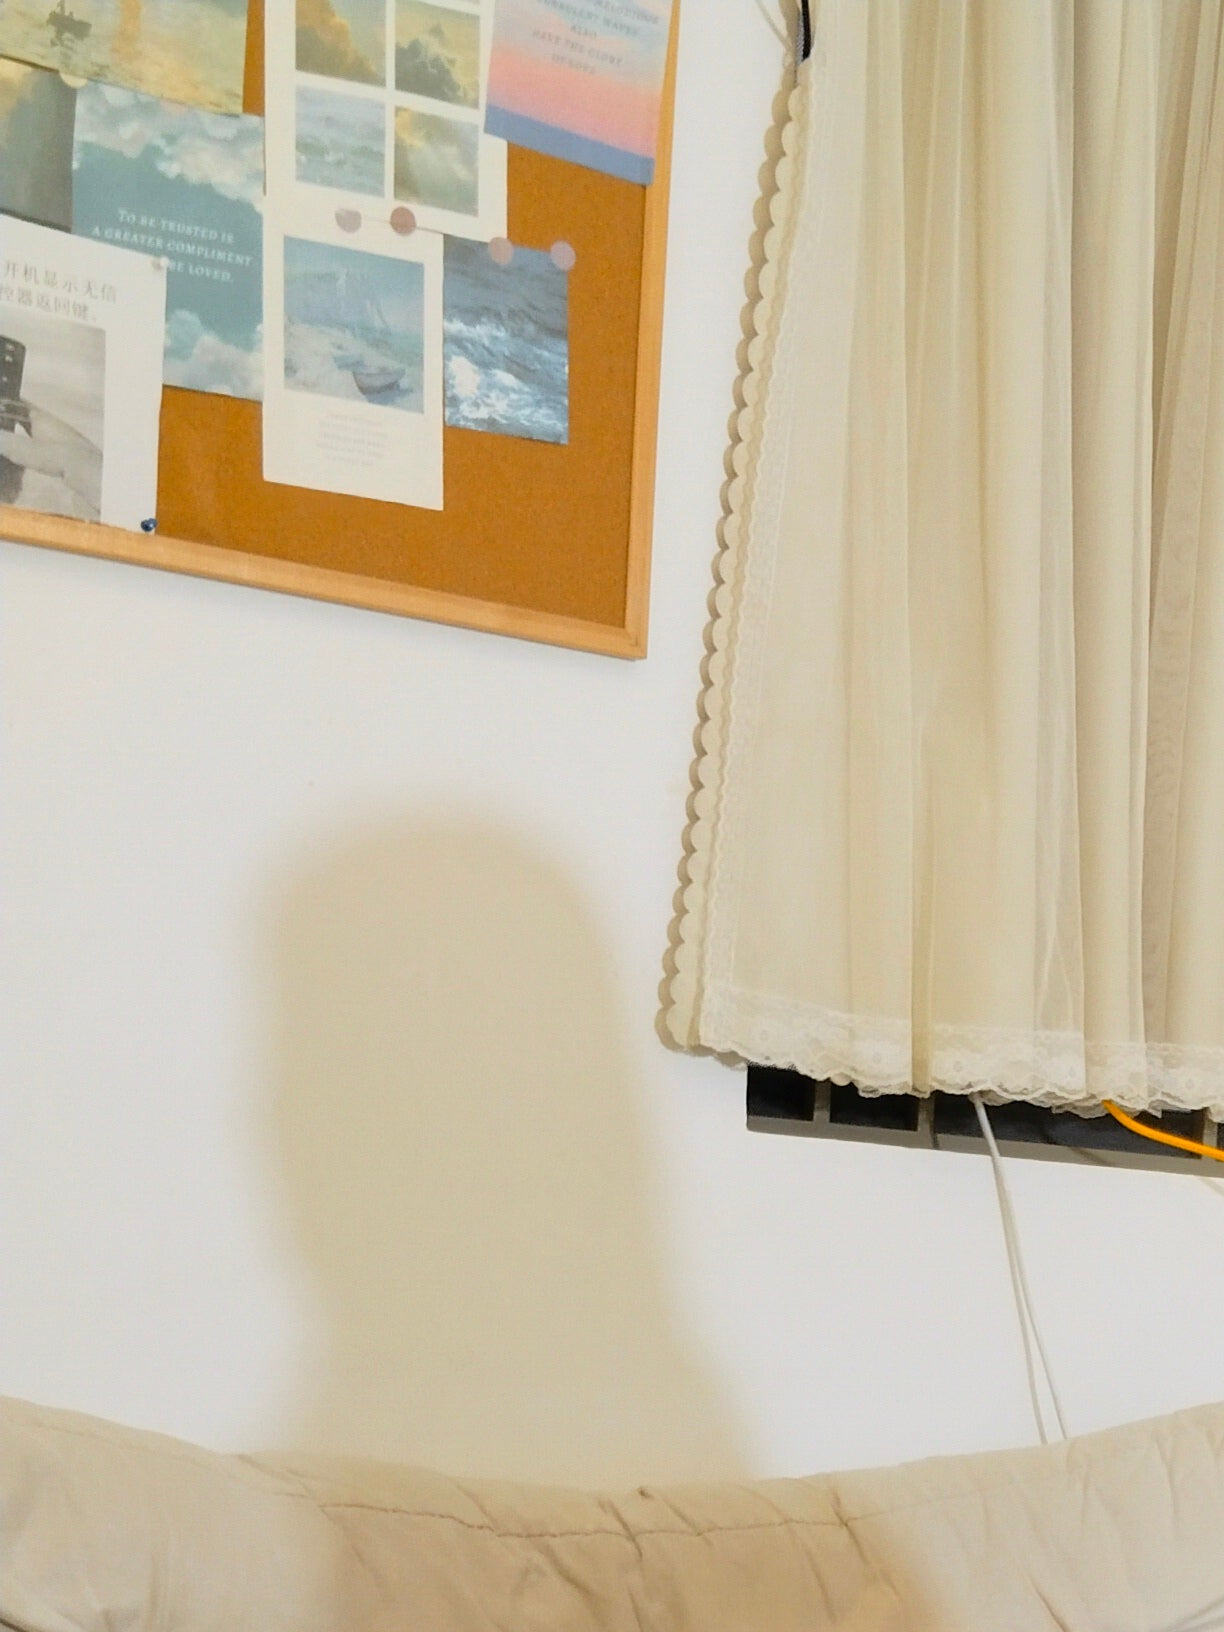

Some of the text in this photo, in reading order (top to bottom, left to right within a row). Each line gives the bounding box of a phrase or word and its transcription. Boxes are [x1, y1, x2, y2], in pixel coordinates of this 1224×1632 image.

[565, 39, 585, 53] THE
[118, 209, 235, 245] TO BE TRUSTED IS
[92, 226, 253, 267] A GREATER COMPLIMENT
